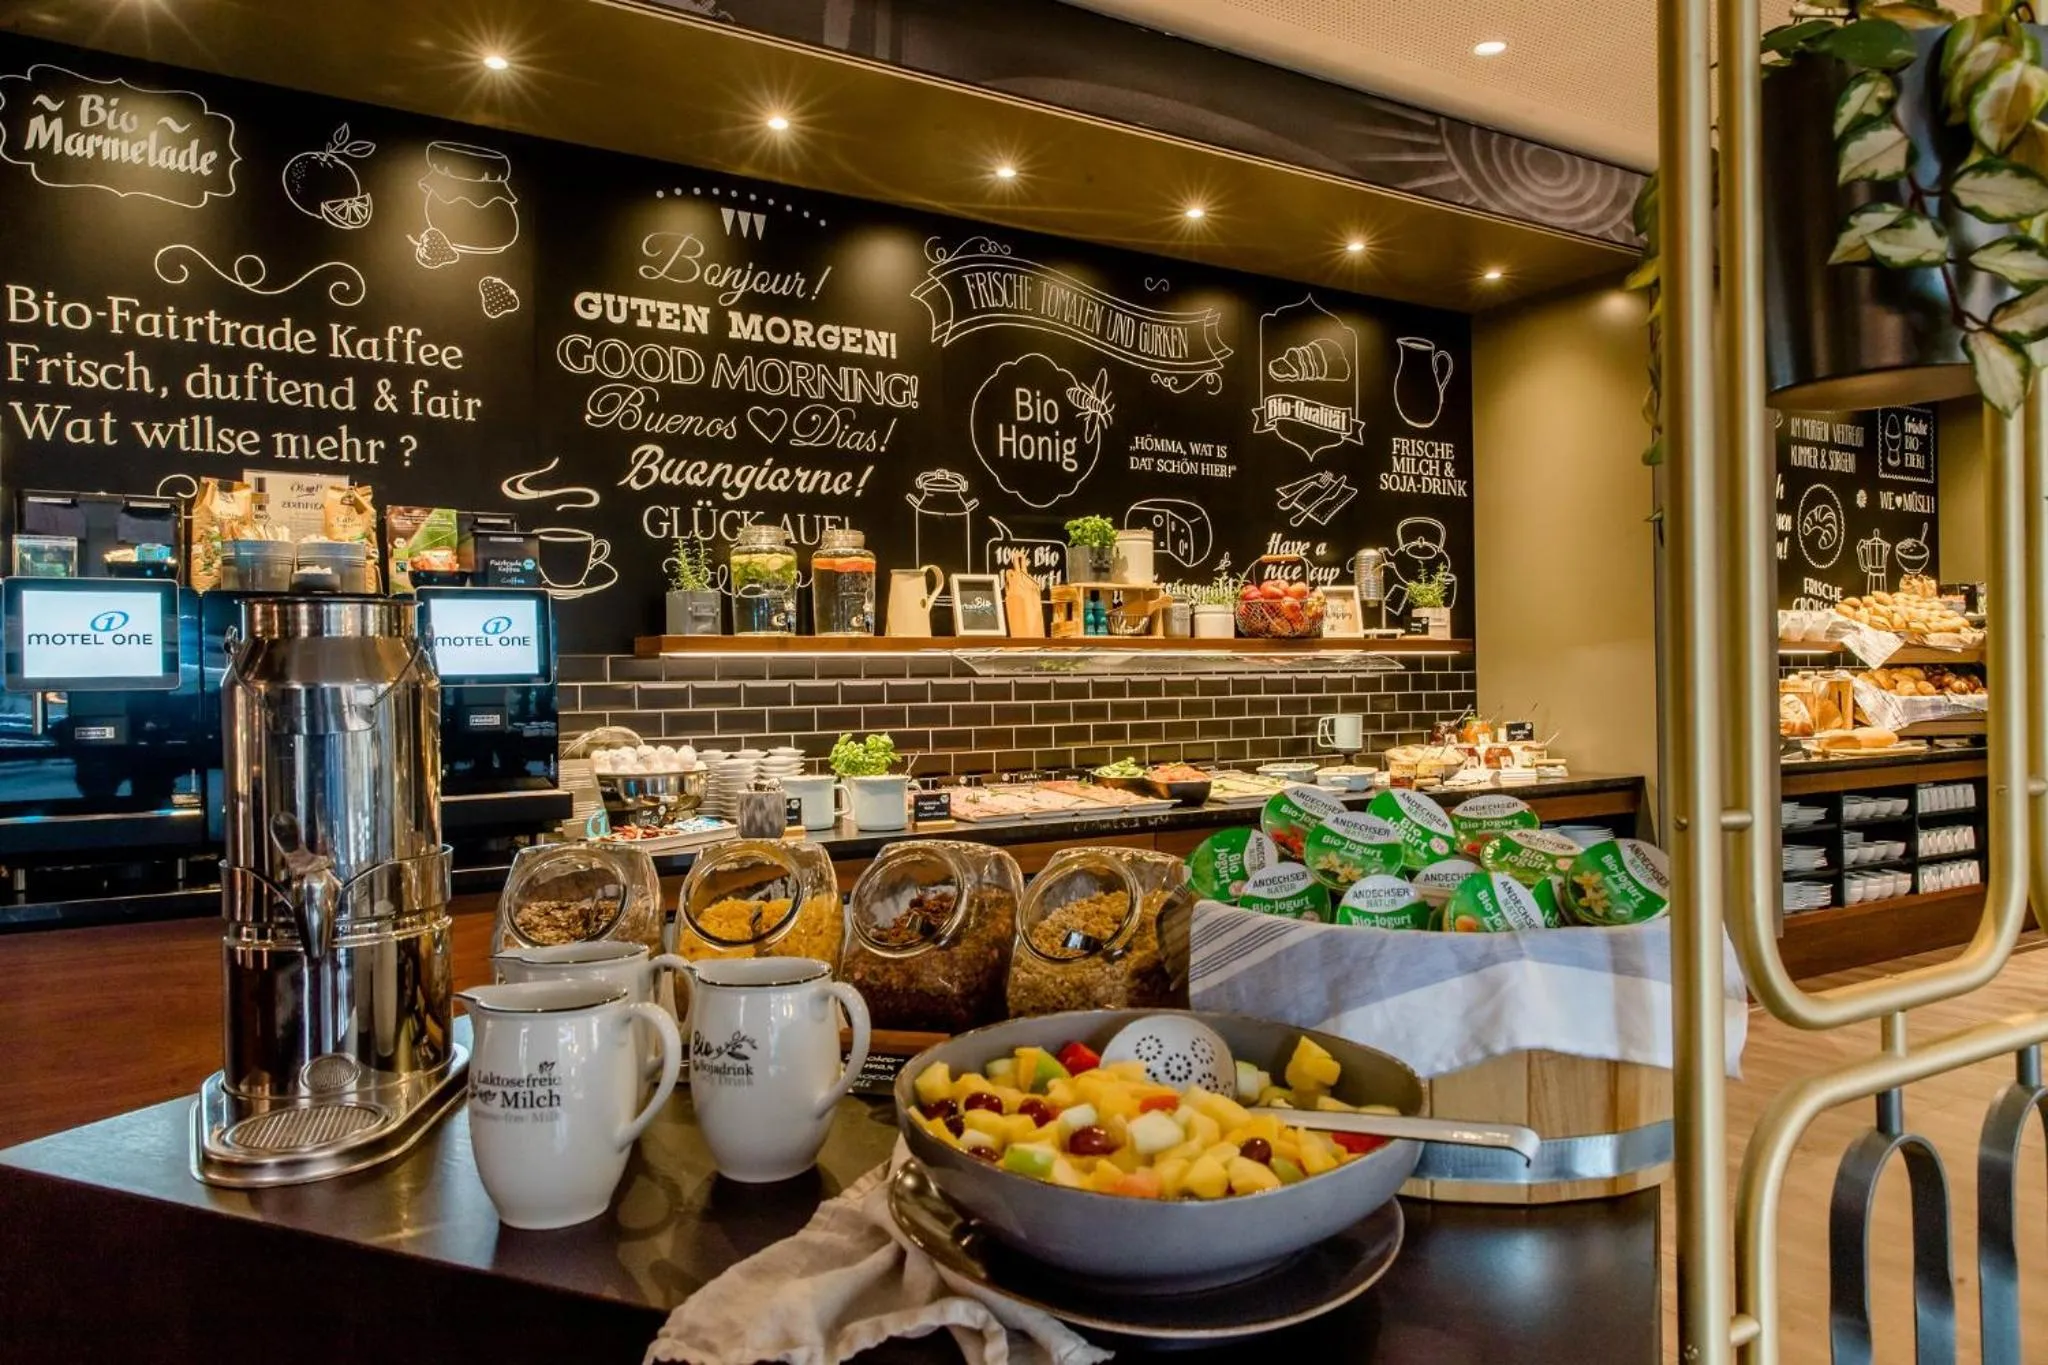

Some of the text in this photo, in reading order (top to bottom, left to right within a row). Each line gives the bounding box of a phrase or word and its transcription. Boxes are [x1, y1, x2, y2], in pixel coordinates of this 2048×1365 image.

[78, 93, 139, 132] Bio
[24, 113, 218, 177] Marmelade
[574, 291, 897, 360] GUTEN MORGEN!
[962, 270, 1035, 312] FRISCHE
[1105, 308, 1136, 349] UND
[1138, 321, 1189, 358] GURKEN
[5, 284, 464, 370] Bio-Fairtrade Kaffee
[7, 342, 482, 422] Frisch, duftend & fair
[556, 334, 918, 408] GOOD MORNING!
[1014, 387, 1059, 425] Bio
[1267, 398, 1348, 431] Bio-Qualität
[584, 383, 897, 453] Buenos Dias!
[9, 402, 418, 468] Wat willse mehr ?
[998, 423, 1078, 472] Honig
[1189, 441, 1214, 456] WAT
[1216, 445, 1227, 458] IS
[1392, 438, 1455, 459] FRISCHE
[1129, 456, 1154, 470] DAT
[1157, 458, 1198, 474] SCHÖN
[1392, 456, 1455, 478] MILCH &
[1379, 473, 1468, 497] SOJA-DRINK
[1880, 491, 1895, 510] WE
[643, 500, 764, 546] GLÜCK
[1267, 533, 1327, 555] Have a
[1034, 546, 1059, 567] Bio
[1264, 560, 1340, 587] nice cup
[1804, 577, 1843, 602] FRISCHE
[28, 633, 153, 646] MOTEL ONE
[435, 635, 530, 647] MOTEL ONE
[1401, 793, 1448, 829] ANDECHSER
[1333, 817, 1391, 837] ANDECHSER
[1400, 817, 1422, 837] Bio
[1322, 834, 1383, 857] Bio-Jogurt
[1520, 848, 1545, 860] Bio
[1214, 847, 1231, 884] Jogurt
[1228, 853, 1240, 873] Bio
[1502, 852, 1553, 871] Jogurt
[1627, 843, 1670, 889] ANDECHSE
[1252, 871, 1308, 888] ANDECHSER
[1267, 883, 1296, 894] NATUR
[1601, 854, 1645, 902] Bio-Jogurt
[1252, 896, 1309, 914] Bio-Jogurt
[1353, 888, 1410, 899] ANDECHSER
[501, 1089, 561, 1109] Milch
